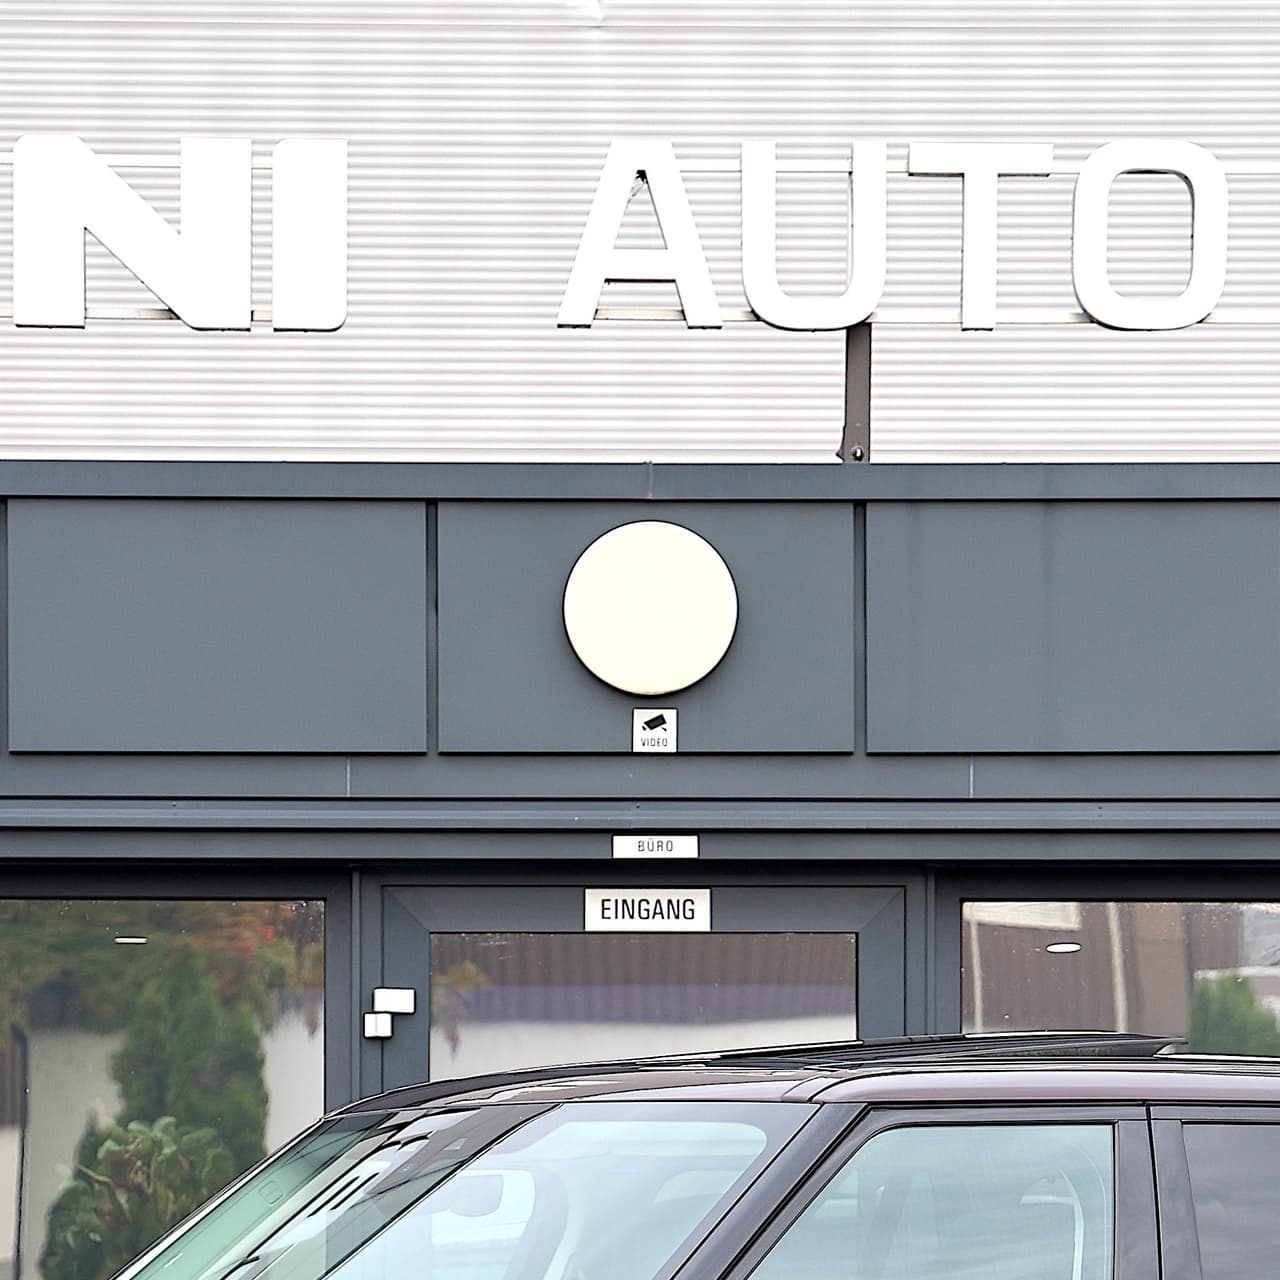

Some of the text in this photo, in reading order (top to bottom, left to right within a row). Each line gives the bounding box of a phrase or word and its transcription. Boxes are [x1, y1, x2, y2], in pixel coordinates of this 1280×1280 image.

[556, 139, 1230, 331] AUTO
[640, 737, 668, 747] VIDEO
[637, 838, 674, 852] BÜRO
[600, 898, 696, 920] EINGANG
